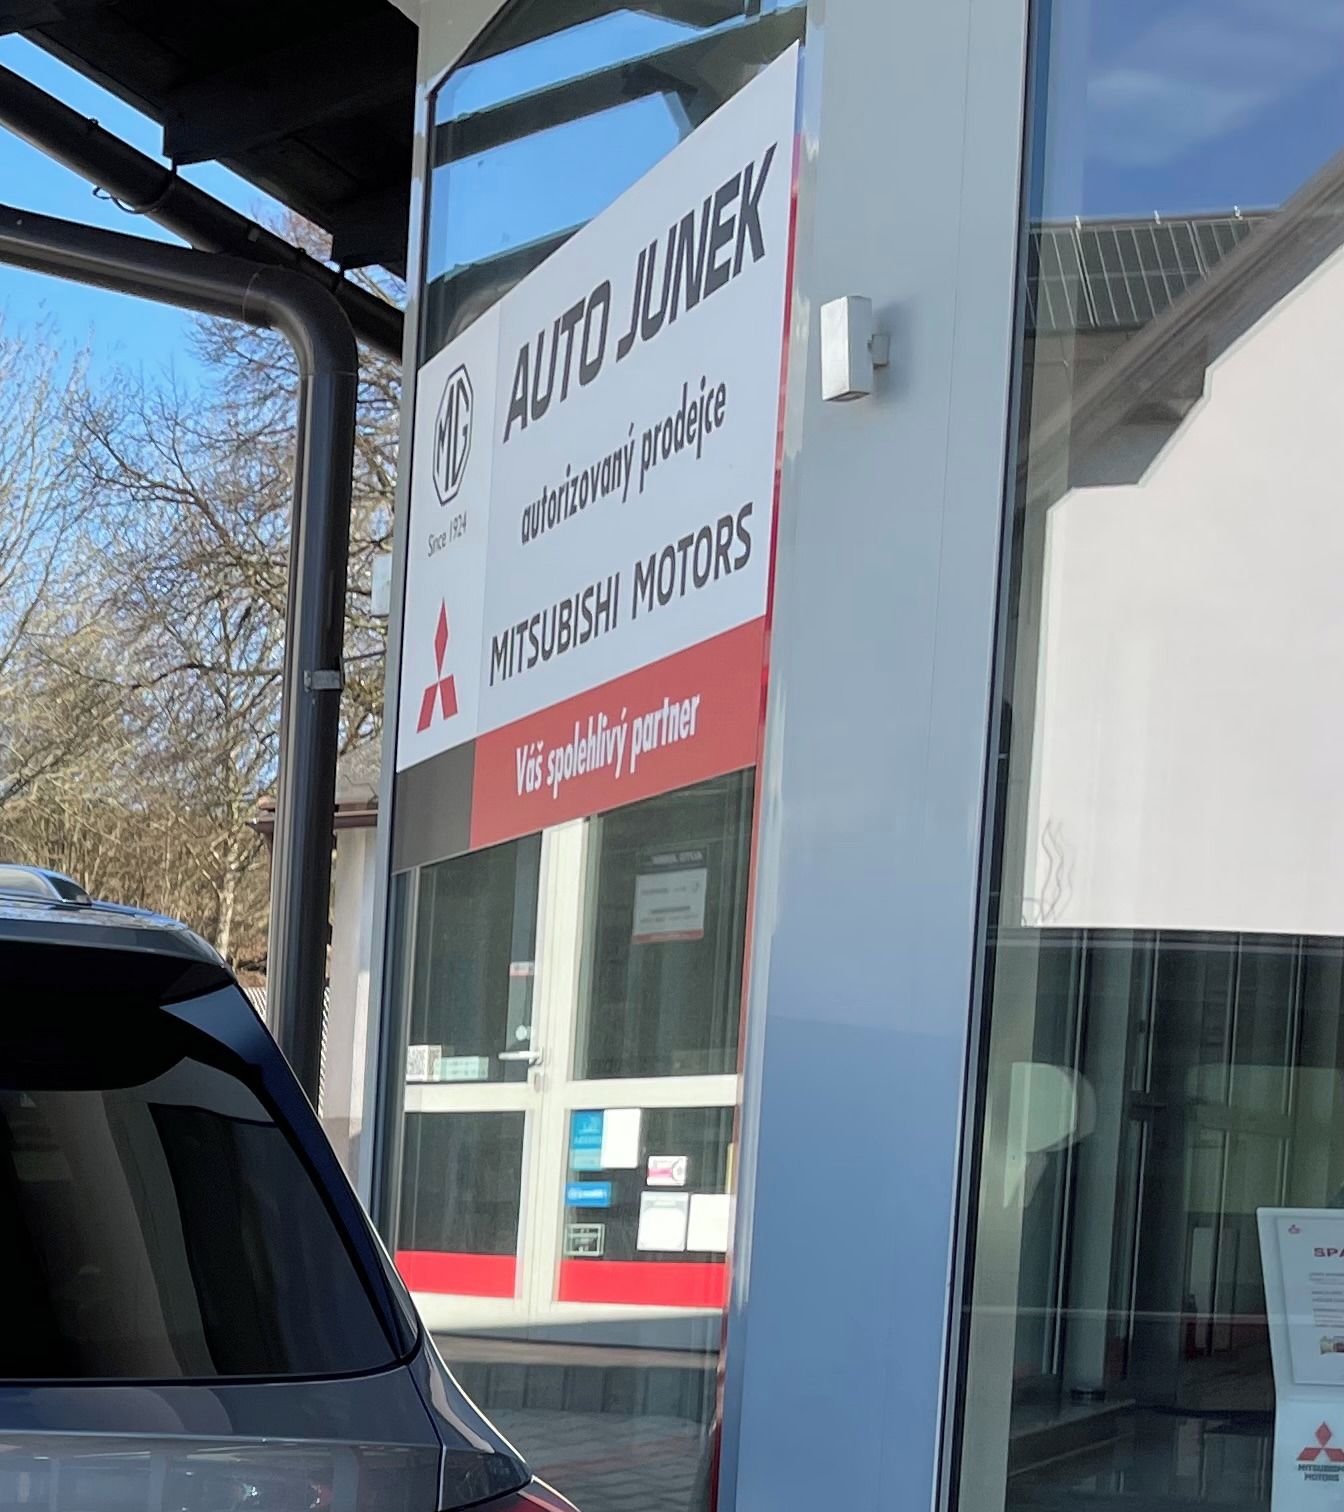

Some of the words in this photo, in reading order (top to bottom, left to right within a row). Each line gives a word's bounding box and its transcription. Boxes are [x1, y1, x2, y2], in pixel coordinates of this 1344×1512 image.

[503, 279, 611, 443] AUTO
[616, 142, 778, 363] JUNEK
[436, 377, 469, 493] MG
[521, 422, 635, 545] autorizovaný
[639, 375, 726, 494] prodejce
[428, 530, 447, 557] Since
[449, 511, 467, 544] 1924
[489, 572, 620, 687] MITSUBISHI
[631, 501, 753, 620] MOTORS
[516, 740, 544, 796] Váš
[546, 706, 628, 799] spolehlivý
[629, 694, 701, 774] partner
